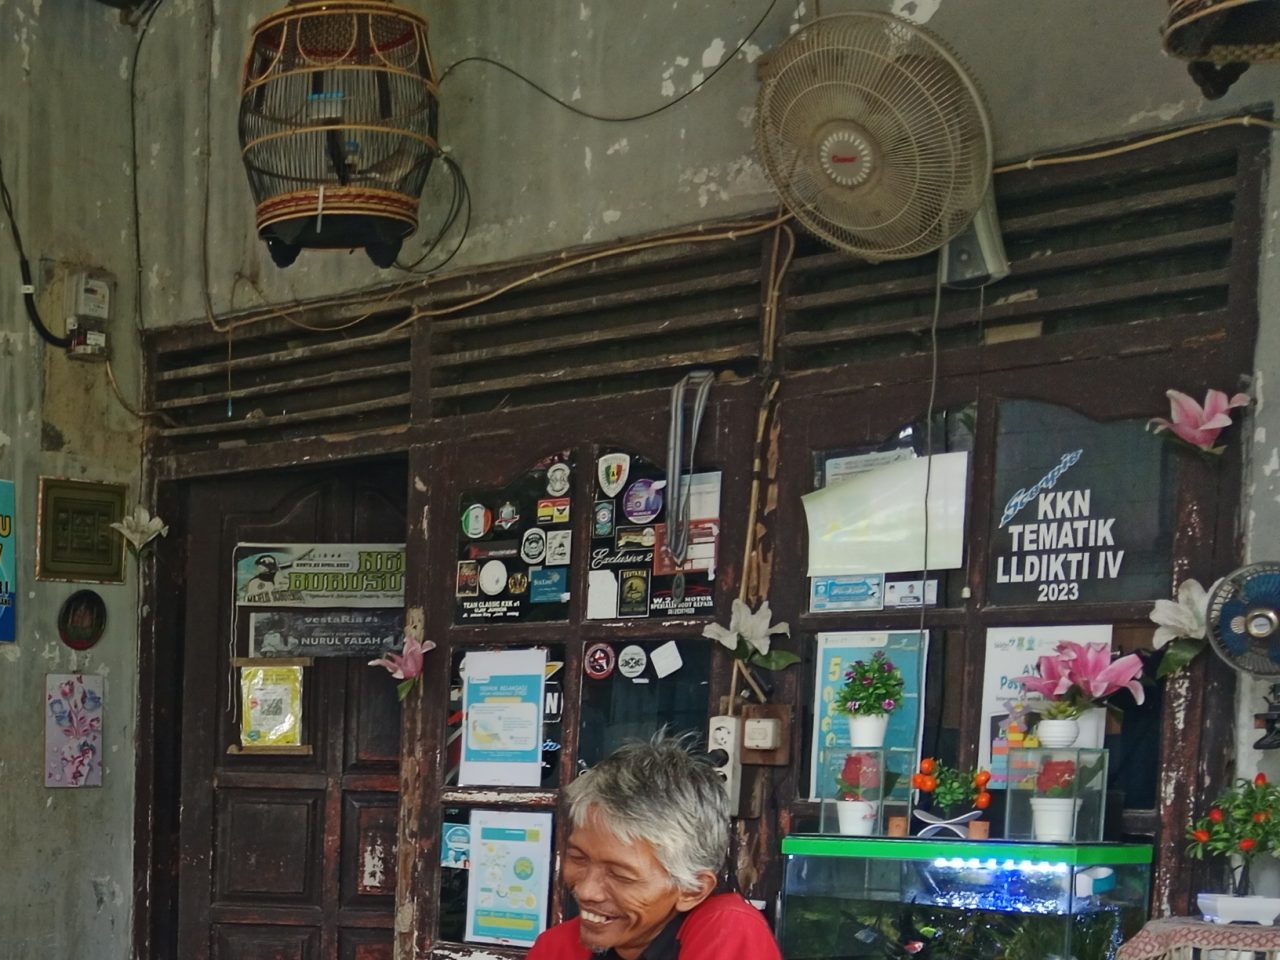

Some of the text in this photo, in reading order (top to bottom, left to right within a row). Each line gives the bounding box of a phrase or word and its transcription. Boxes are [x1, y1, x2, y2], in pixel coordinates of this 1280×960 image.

[1037, 489, 1091, 520] KKN
[1008, 518, 1116, 551] TEMATIK
[592, 548, 643, 569] Exclusive
[996, 550, 1125, 583] LLDIKTI IV
[1037, 583, 1079, 602] 2023
[301, 637, 381, 645] NURUL FALAH
